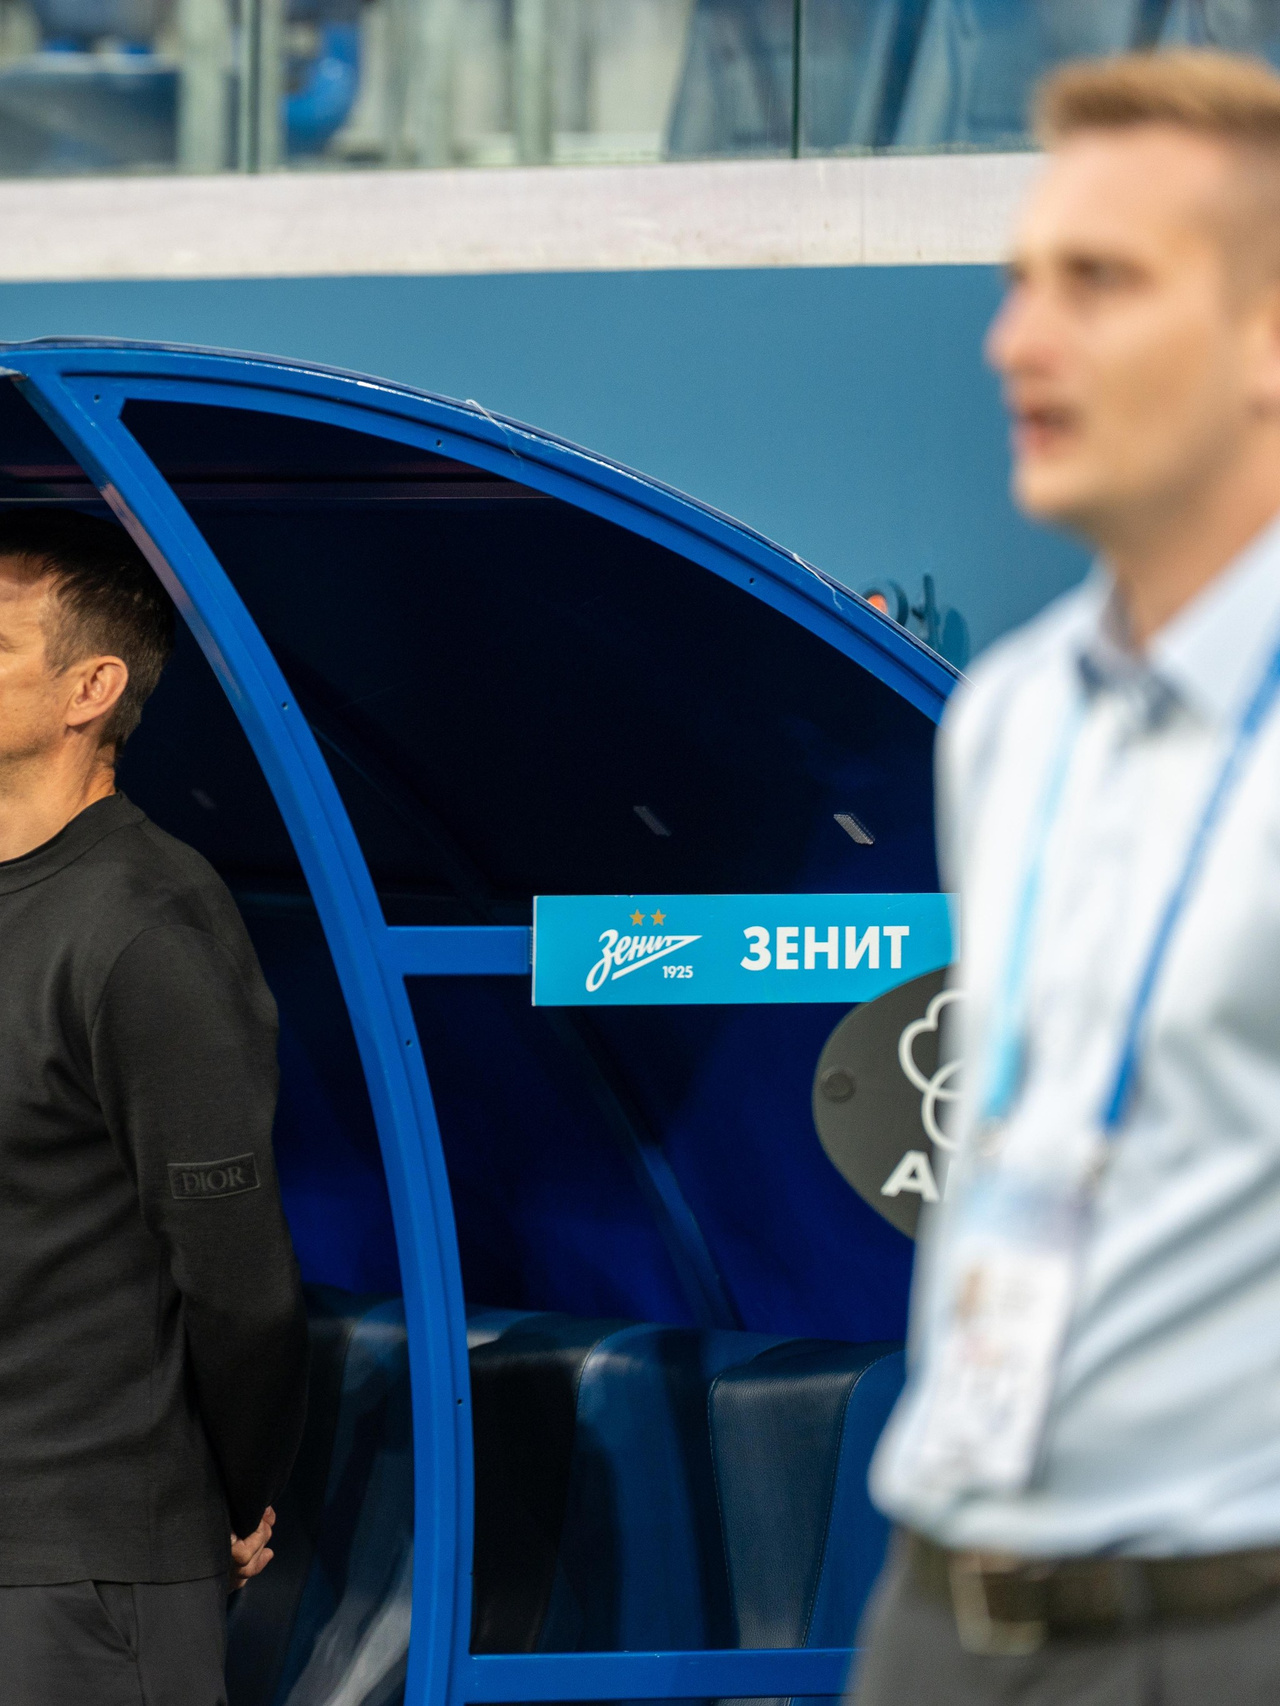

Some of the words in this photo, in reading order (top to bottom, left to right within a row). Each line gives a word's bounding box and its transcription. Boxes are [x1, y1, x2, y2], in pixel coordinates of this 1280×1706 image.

[739, 925, 910, 971] ЗЕНИТ
[662, 965, 694, 979] 1925
[181, 1165, 247, 1195] DIOR
